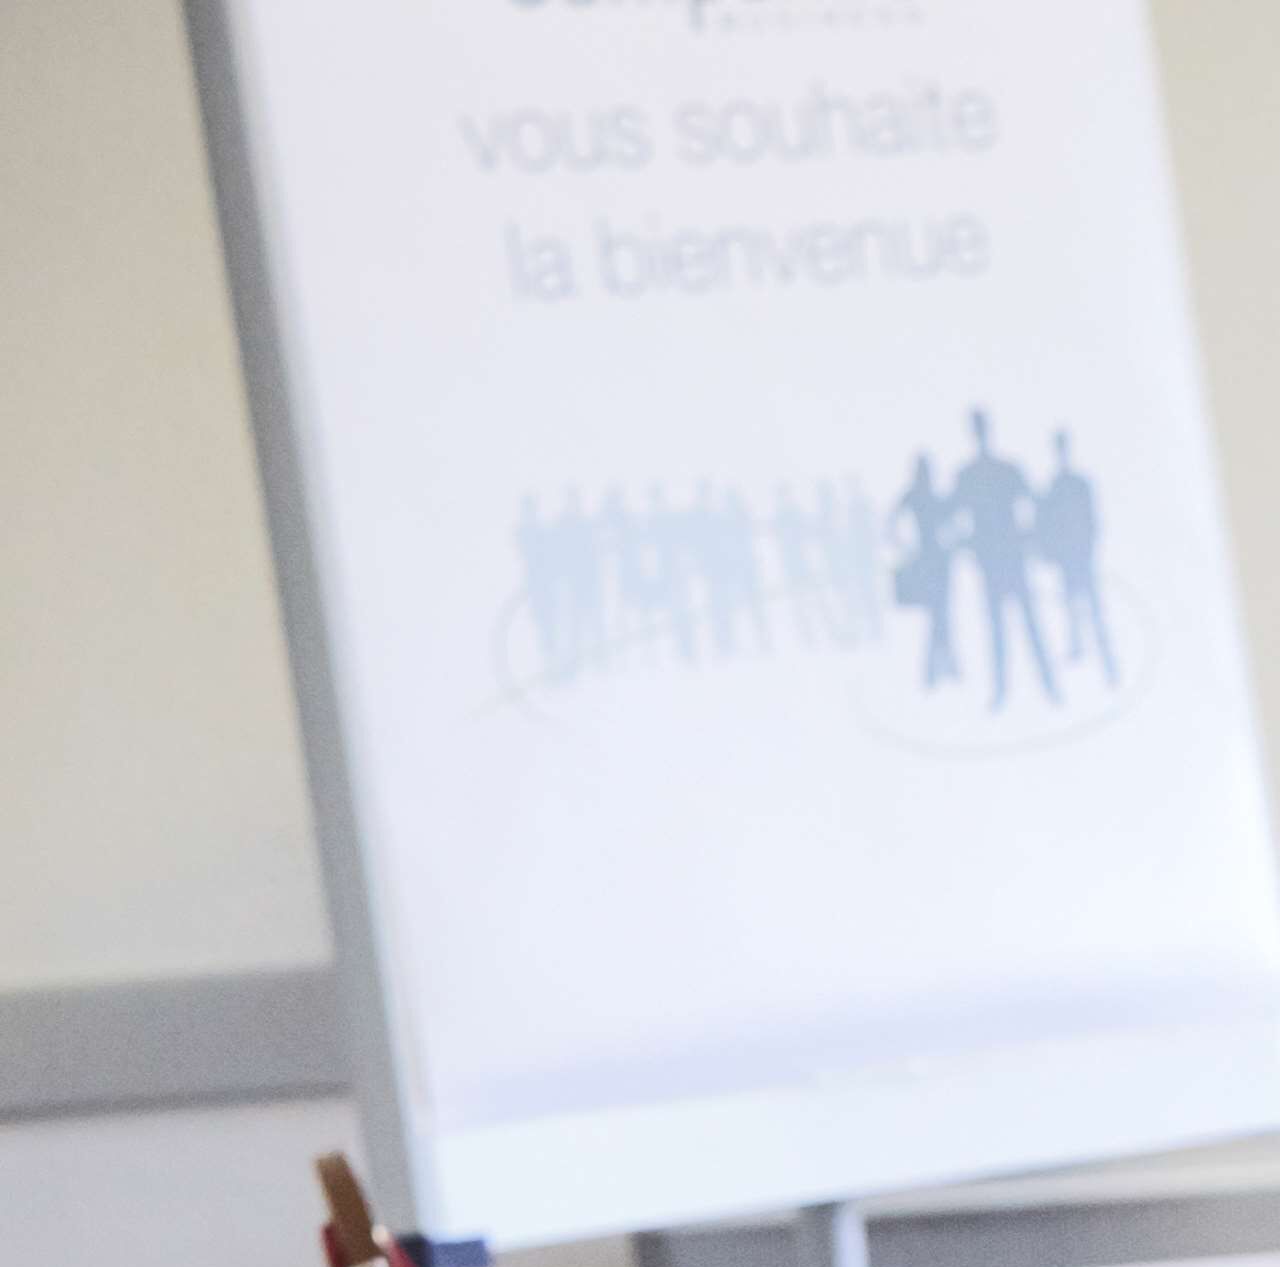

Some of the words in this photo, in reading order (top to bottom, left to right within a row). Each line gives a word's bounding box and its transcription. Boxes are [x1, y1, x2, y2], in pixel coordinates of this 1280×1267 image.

[457, 102, 654, 175] vous
[673, 80, 1000, 168] souhaite
[504, 218, 578, 302] la
[599, 210, 992, 299] bienvenue
